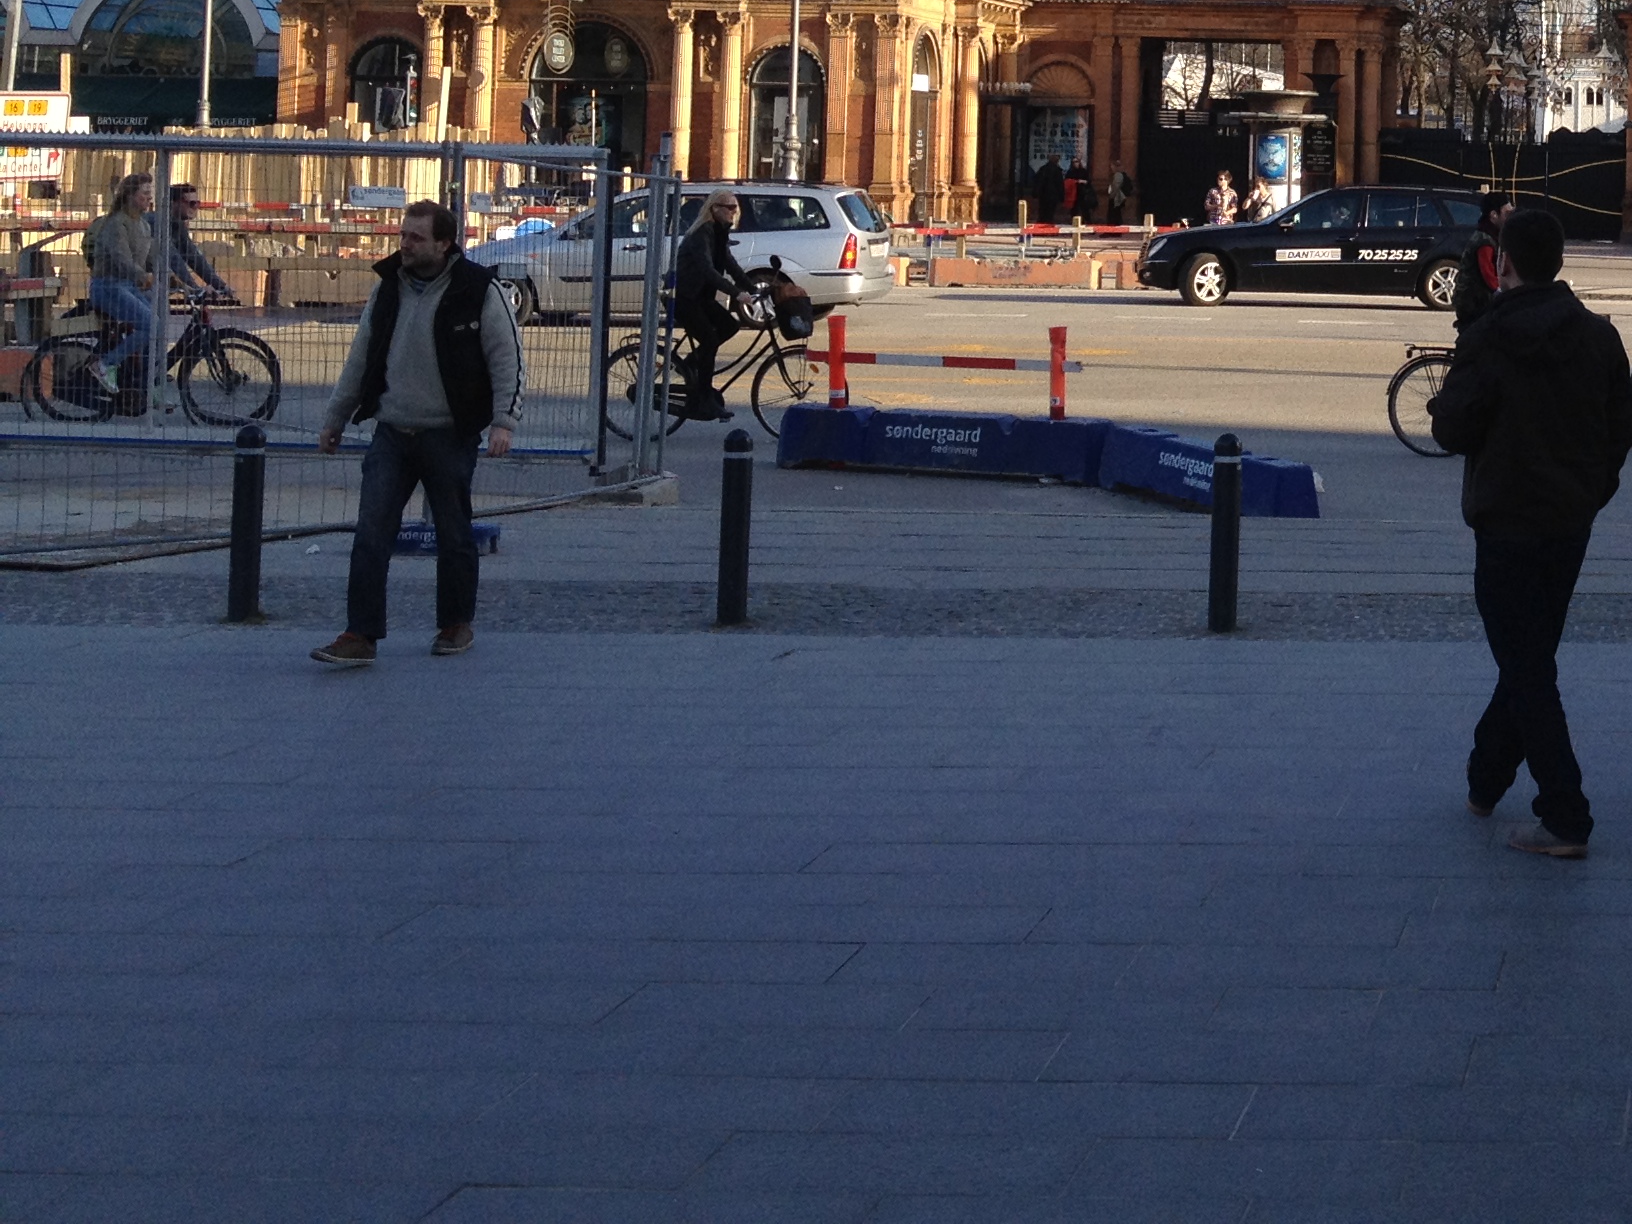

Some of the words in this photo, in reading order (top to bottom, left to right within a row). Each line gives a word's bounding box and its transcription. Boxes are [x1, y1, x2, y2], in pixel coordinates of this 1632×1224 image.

[97, 117, 148, 126] BRYGGERIET
[211, 118, 256, 126] RYGGERIET
[1287, 250, 1331, 260] DANTAXI
[885, 424, 981, 444] søndergaard
